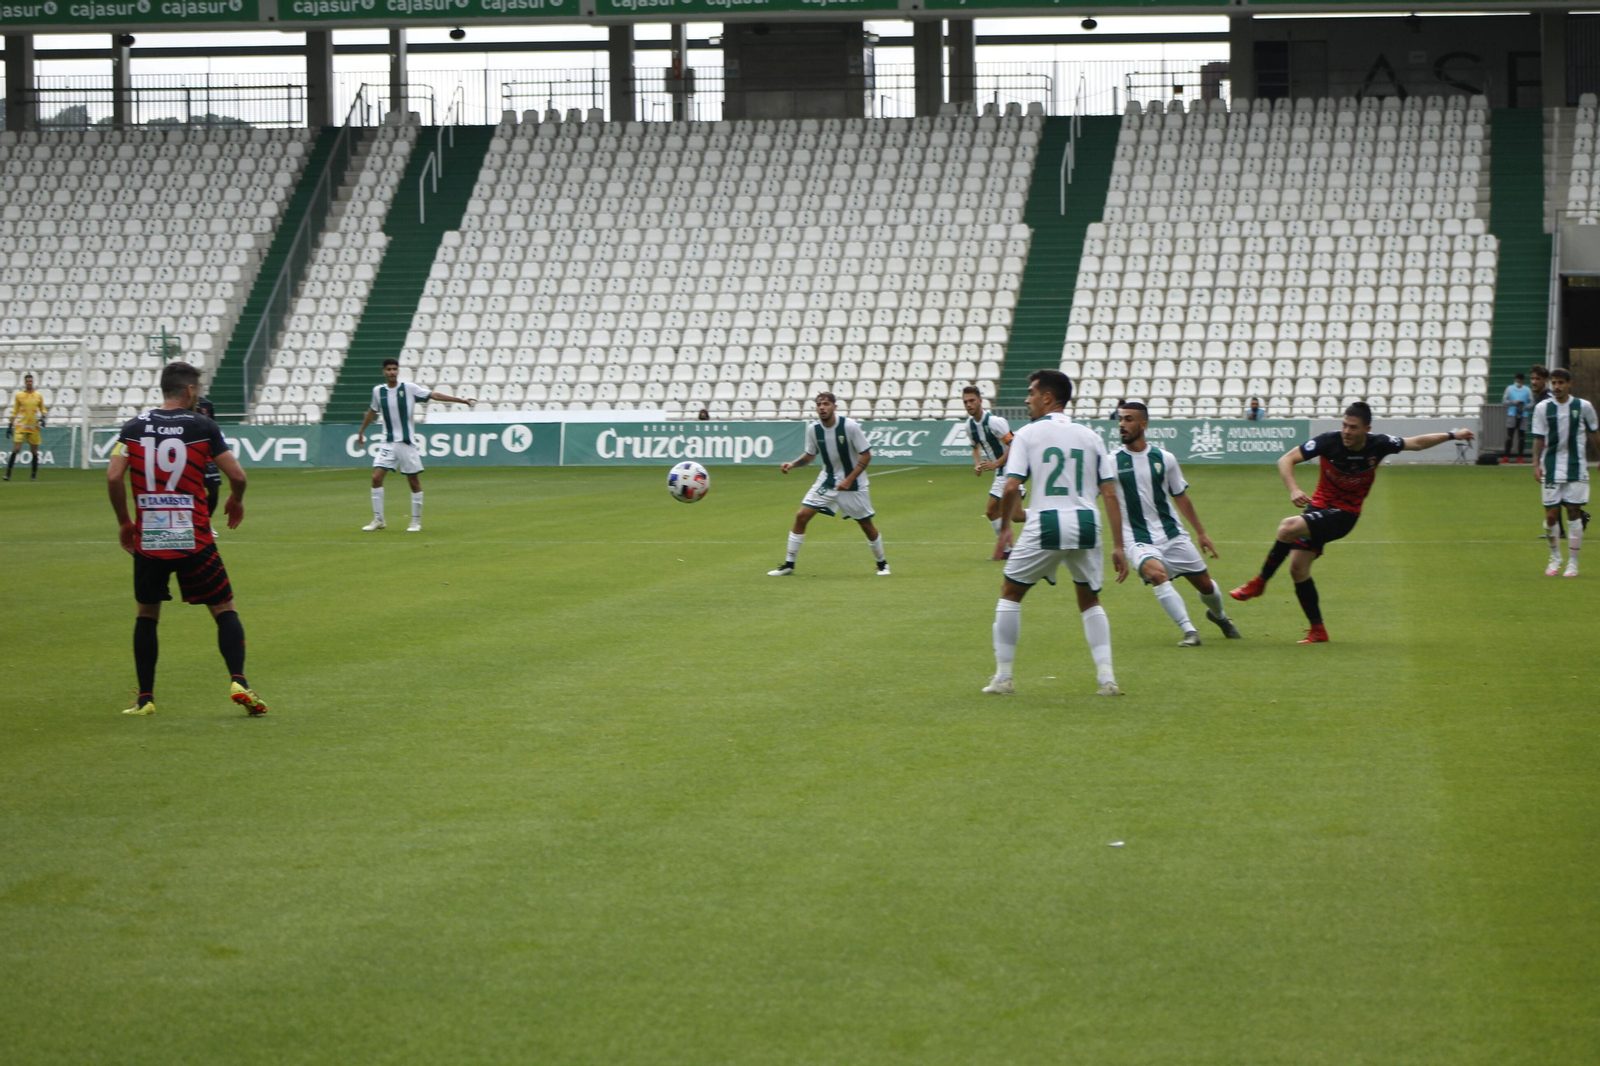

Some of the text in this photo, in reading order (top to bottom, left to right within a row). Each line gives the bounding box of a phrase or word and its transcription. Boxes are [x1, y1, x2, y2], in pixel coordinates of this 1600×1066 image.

[70, 1, 135, 20] cajasur
[161, 0, 227, 17] cajasur
[293, 0, 359, 16] cajasur
[157, 426, 184, 435] CANO
[1226, 427, 1296, 439] AYUNTAMIENTO
[346, 432, 498, 457] caasur
[596, 428, 773, 463] Cruzcampo
[1226, 441, 1239, 452] DE
[140, 436, 187, 491] 19
[1042, 447, 1083, 497] 21
